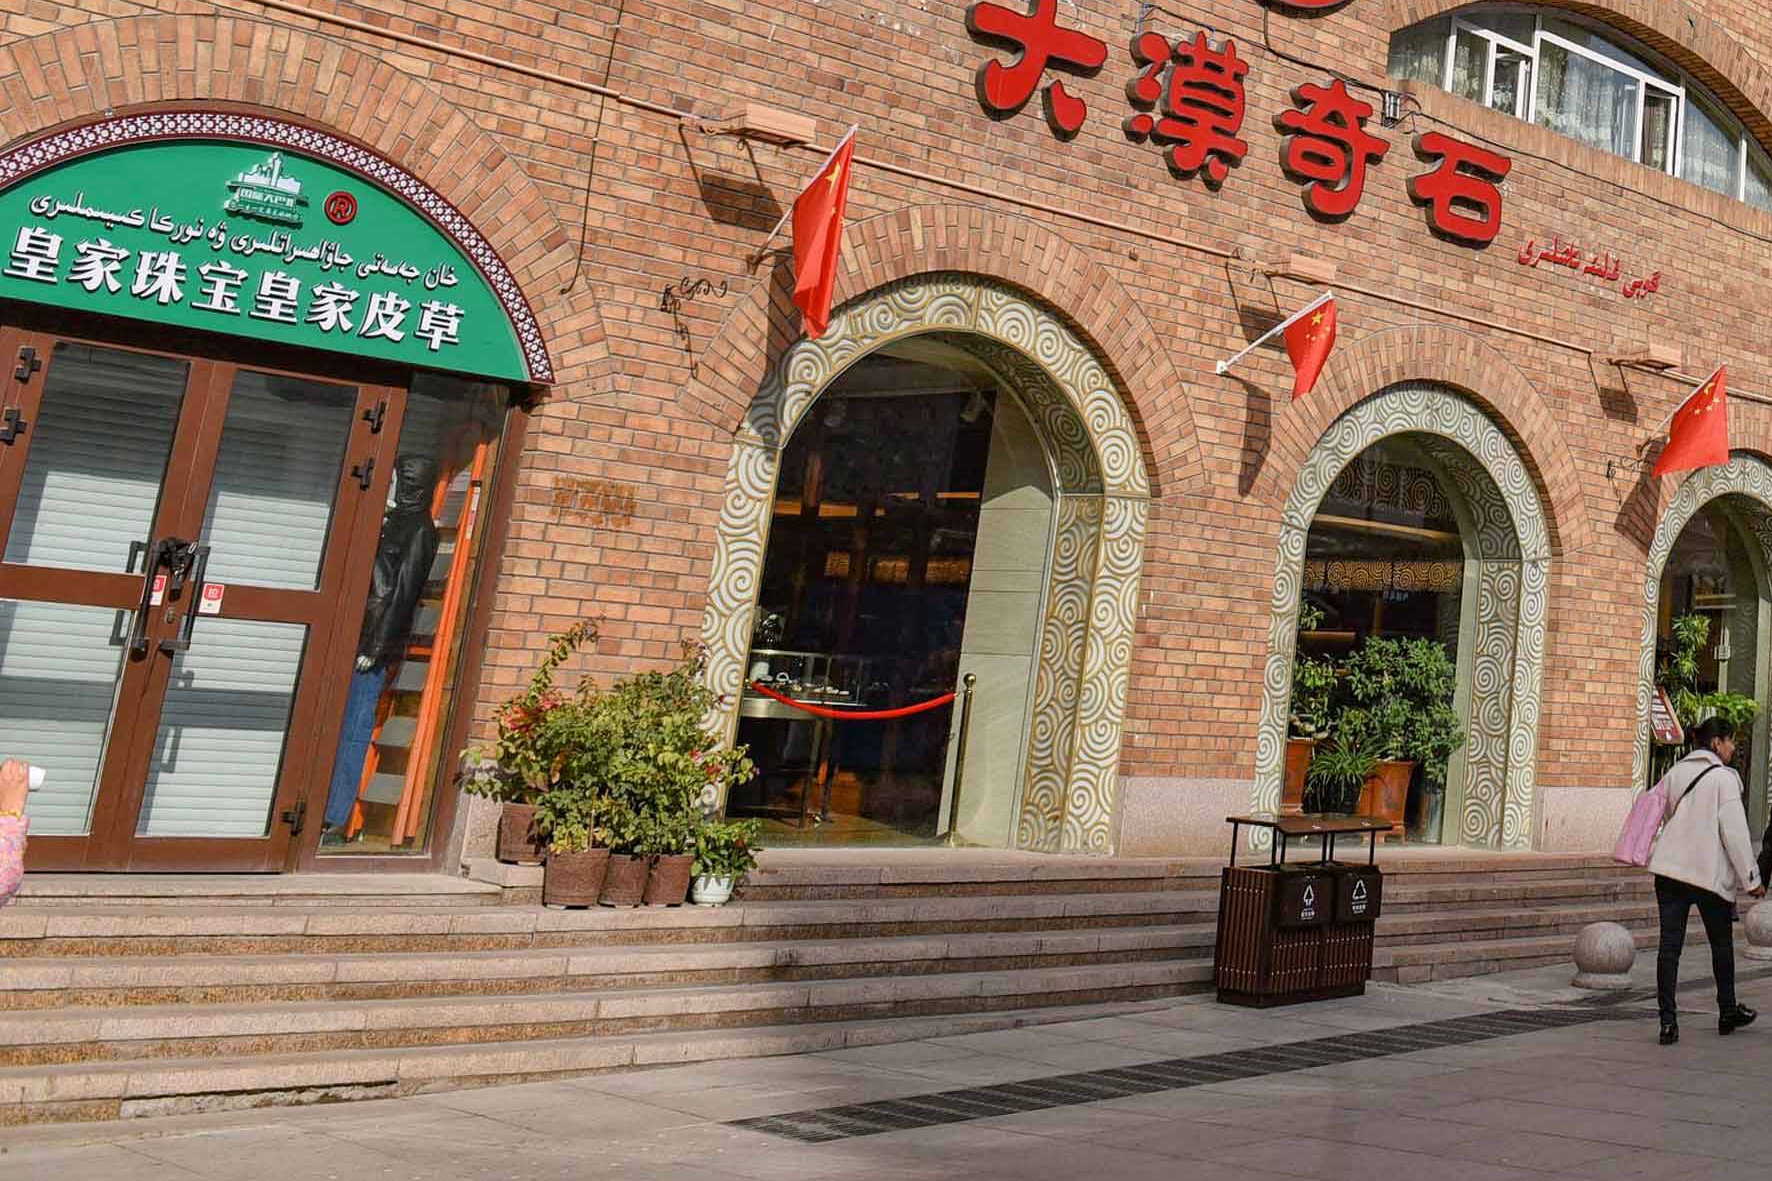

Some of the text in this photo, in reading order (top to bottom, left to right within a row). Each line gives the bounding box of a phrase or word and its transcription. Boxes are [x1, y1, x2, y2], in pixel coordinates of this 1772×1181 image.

[2, 225, 466, 351] 皇家珠宝皇家皮草
